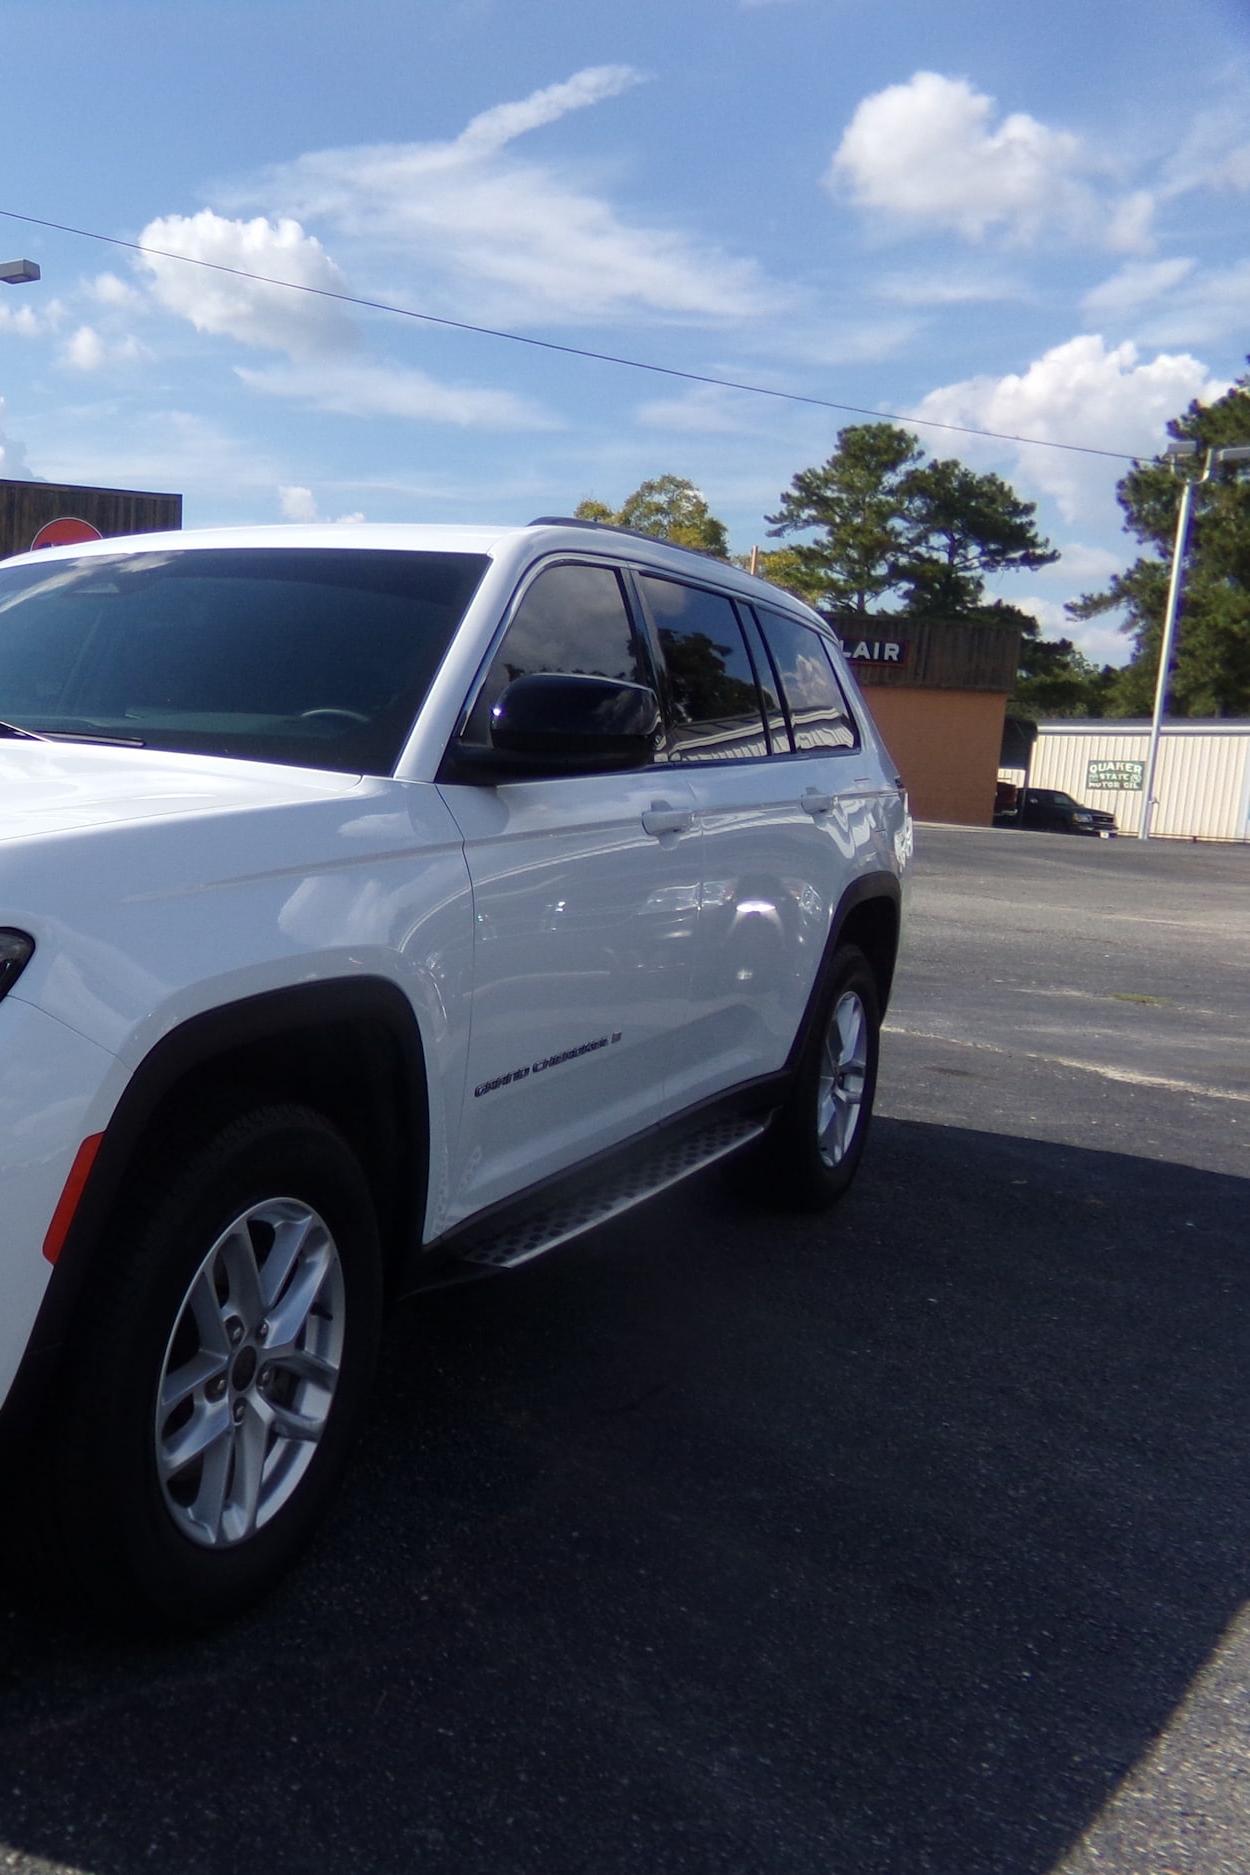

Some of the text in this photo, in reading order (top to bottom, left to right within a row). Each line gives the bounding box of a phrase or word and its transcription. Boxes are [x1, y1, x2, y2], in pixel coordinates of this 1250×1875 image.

[839, 641, 900, 662] LAIR
[1089, 761, 1143, 775] QUAKER
[1099, 773, 1130, 781] STATE
[1088, 781, 1140, 790] MOTOR OIL
